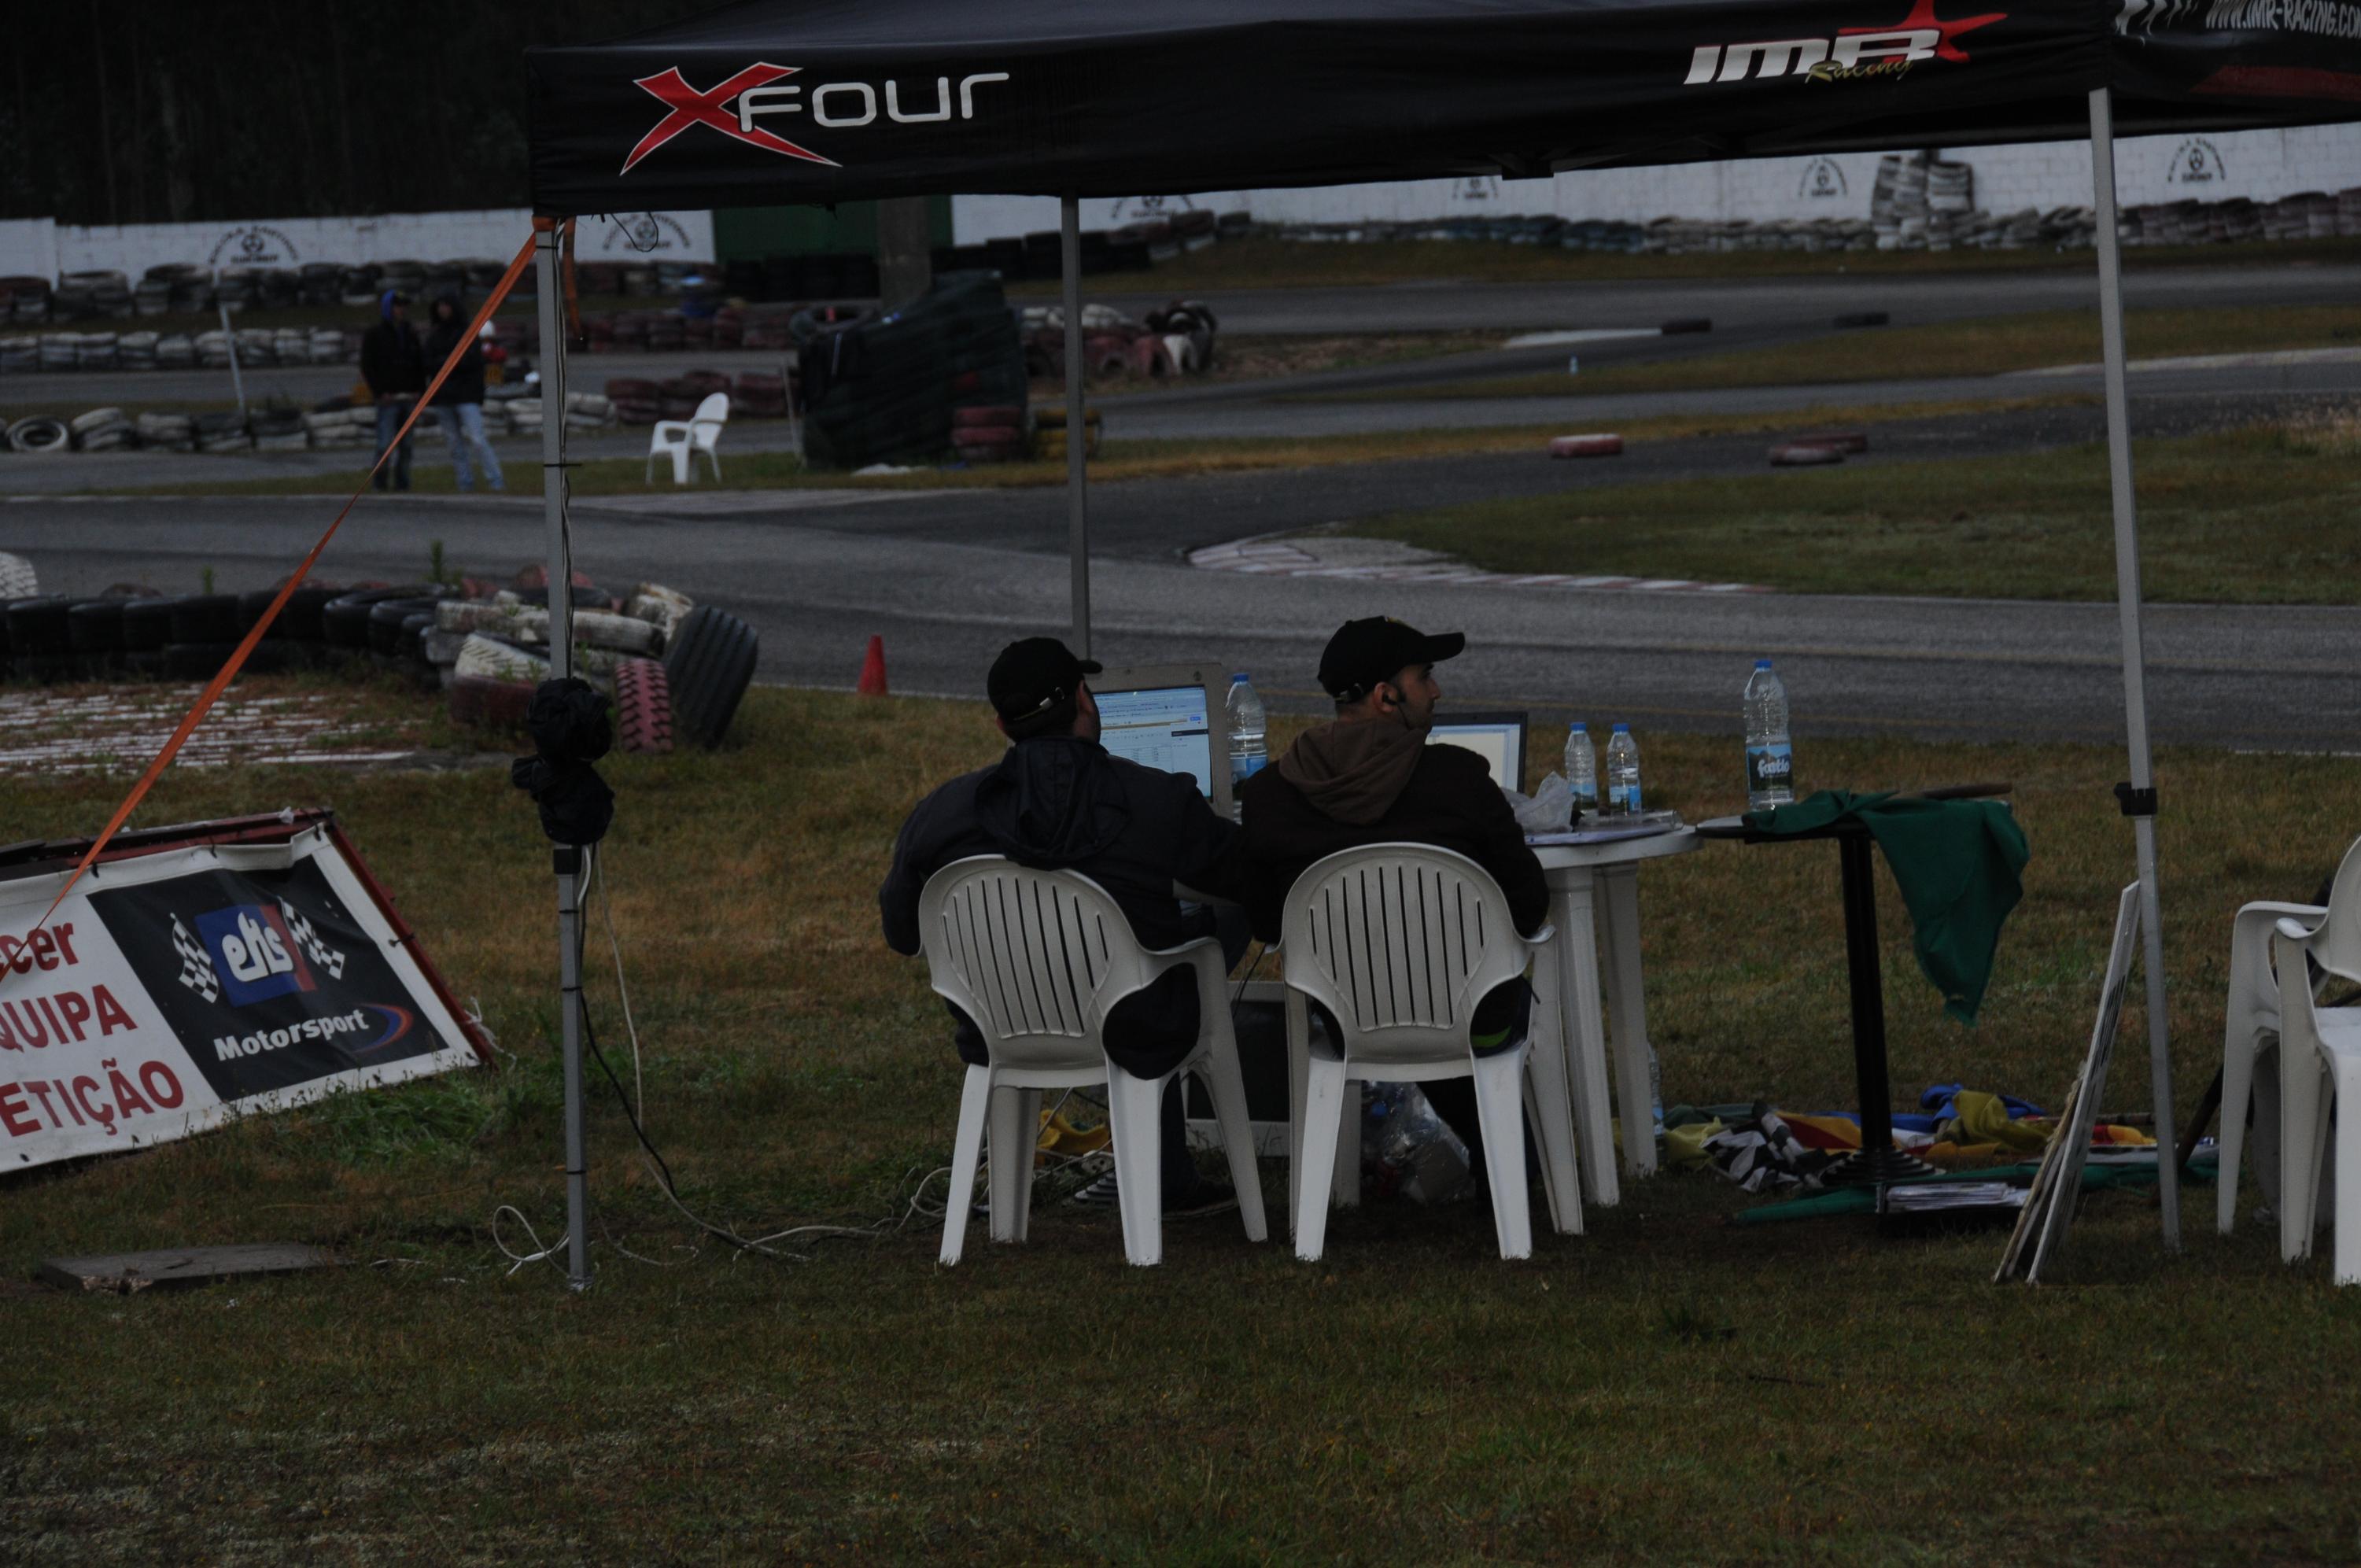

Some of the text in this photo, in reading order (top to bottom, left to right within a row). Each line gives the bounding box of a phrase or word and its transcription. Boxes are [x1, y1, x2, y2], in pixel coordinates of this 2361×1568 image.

[1804, 60, 1914, 84] Racing
[0, 923, 79, 974] cer
[213, 1009, 370, 1061] Motorsport
